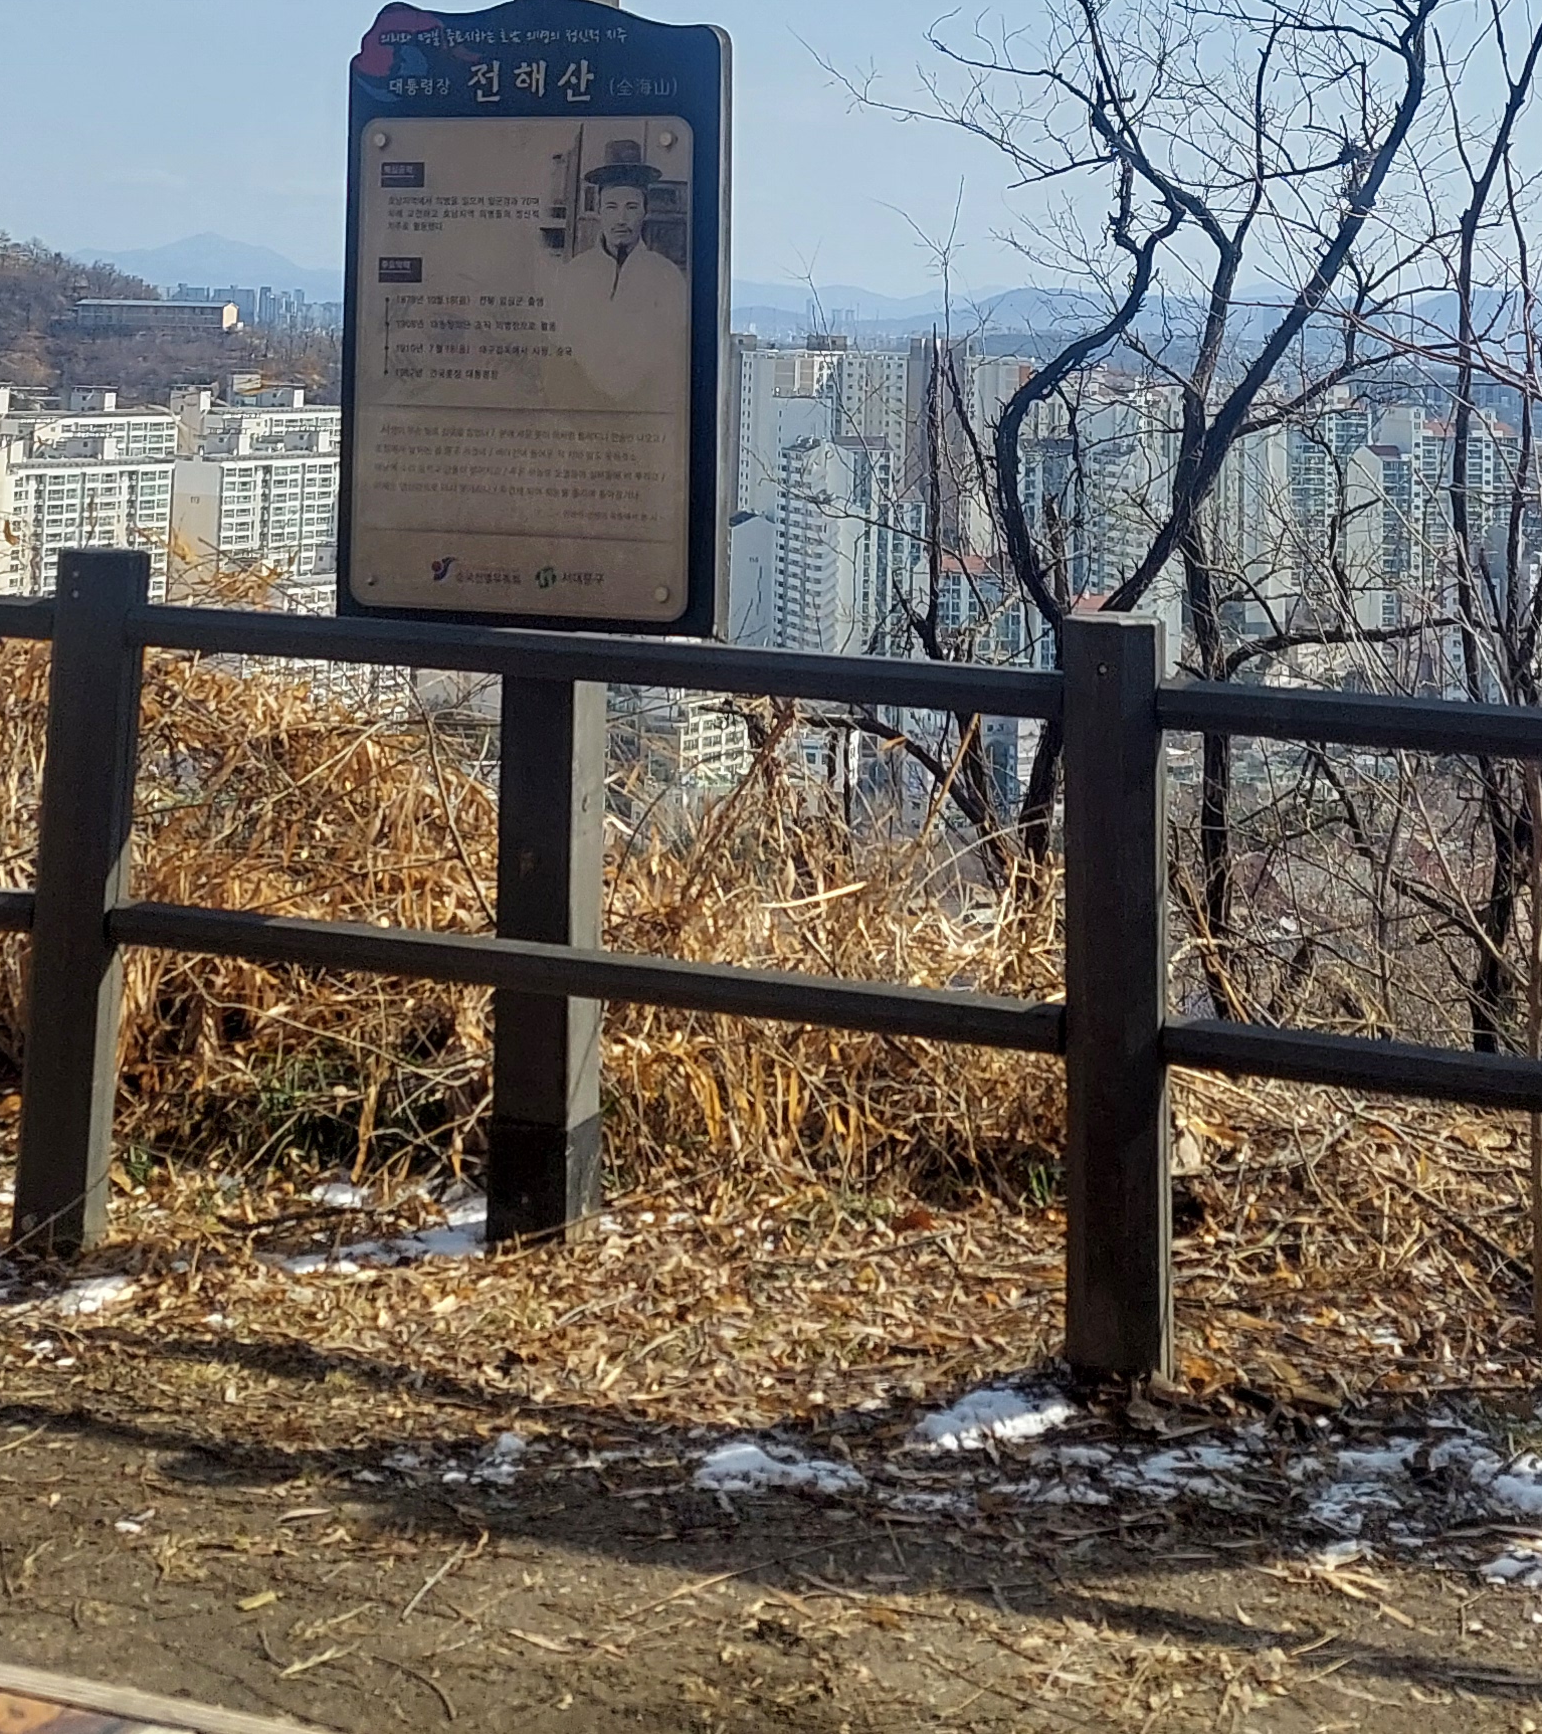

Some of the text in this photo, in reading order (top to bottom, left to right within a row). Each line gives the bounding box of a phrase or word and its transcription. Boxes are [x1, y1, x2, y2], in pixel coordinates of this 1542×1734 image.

[526, 29, 559, 44] 의병의
[565, 29, 599, 43] 정신적
[606, 27, 628, 43] 지주
[388, 59, 678, 103] 대통령장 전해산 (全海山)
